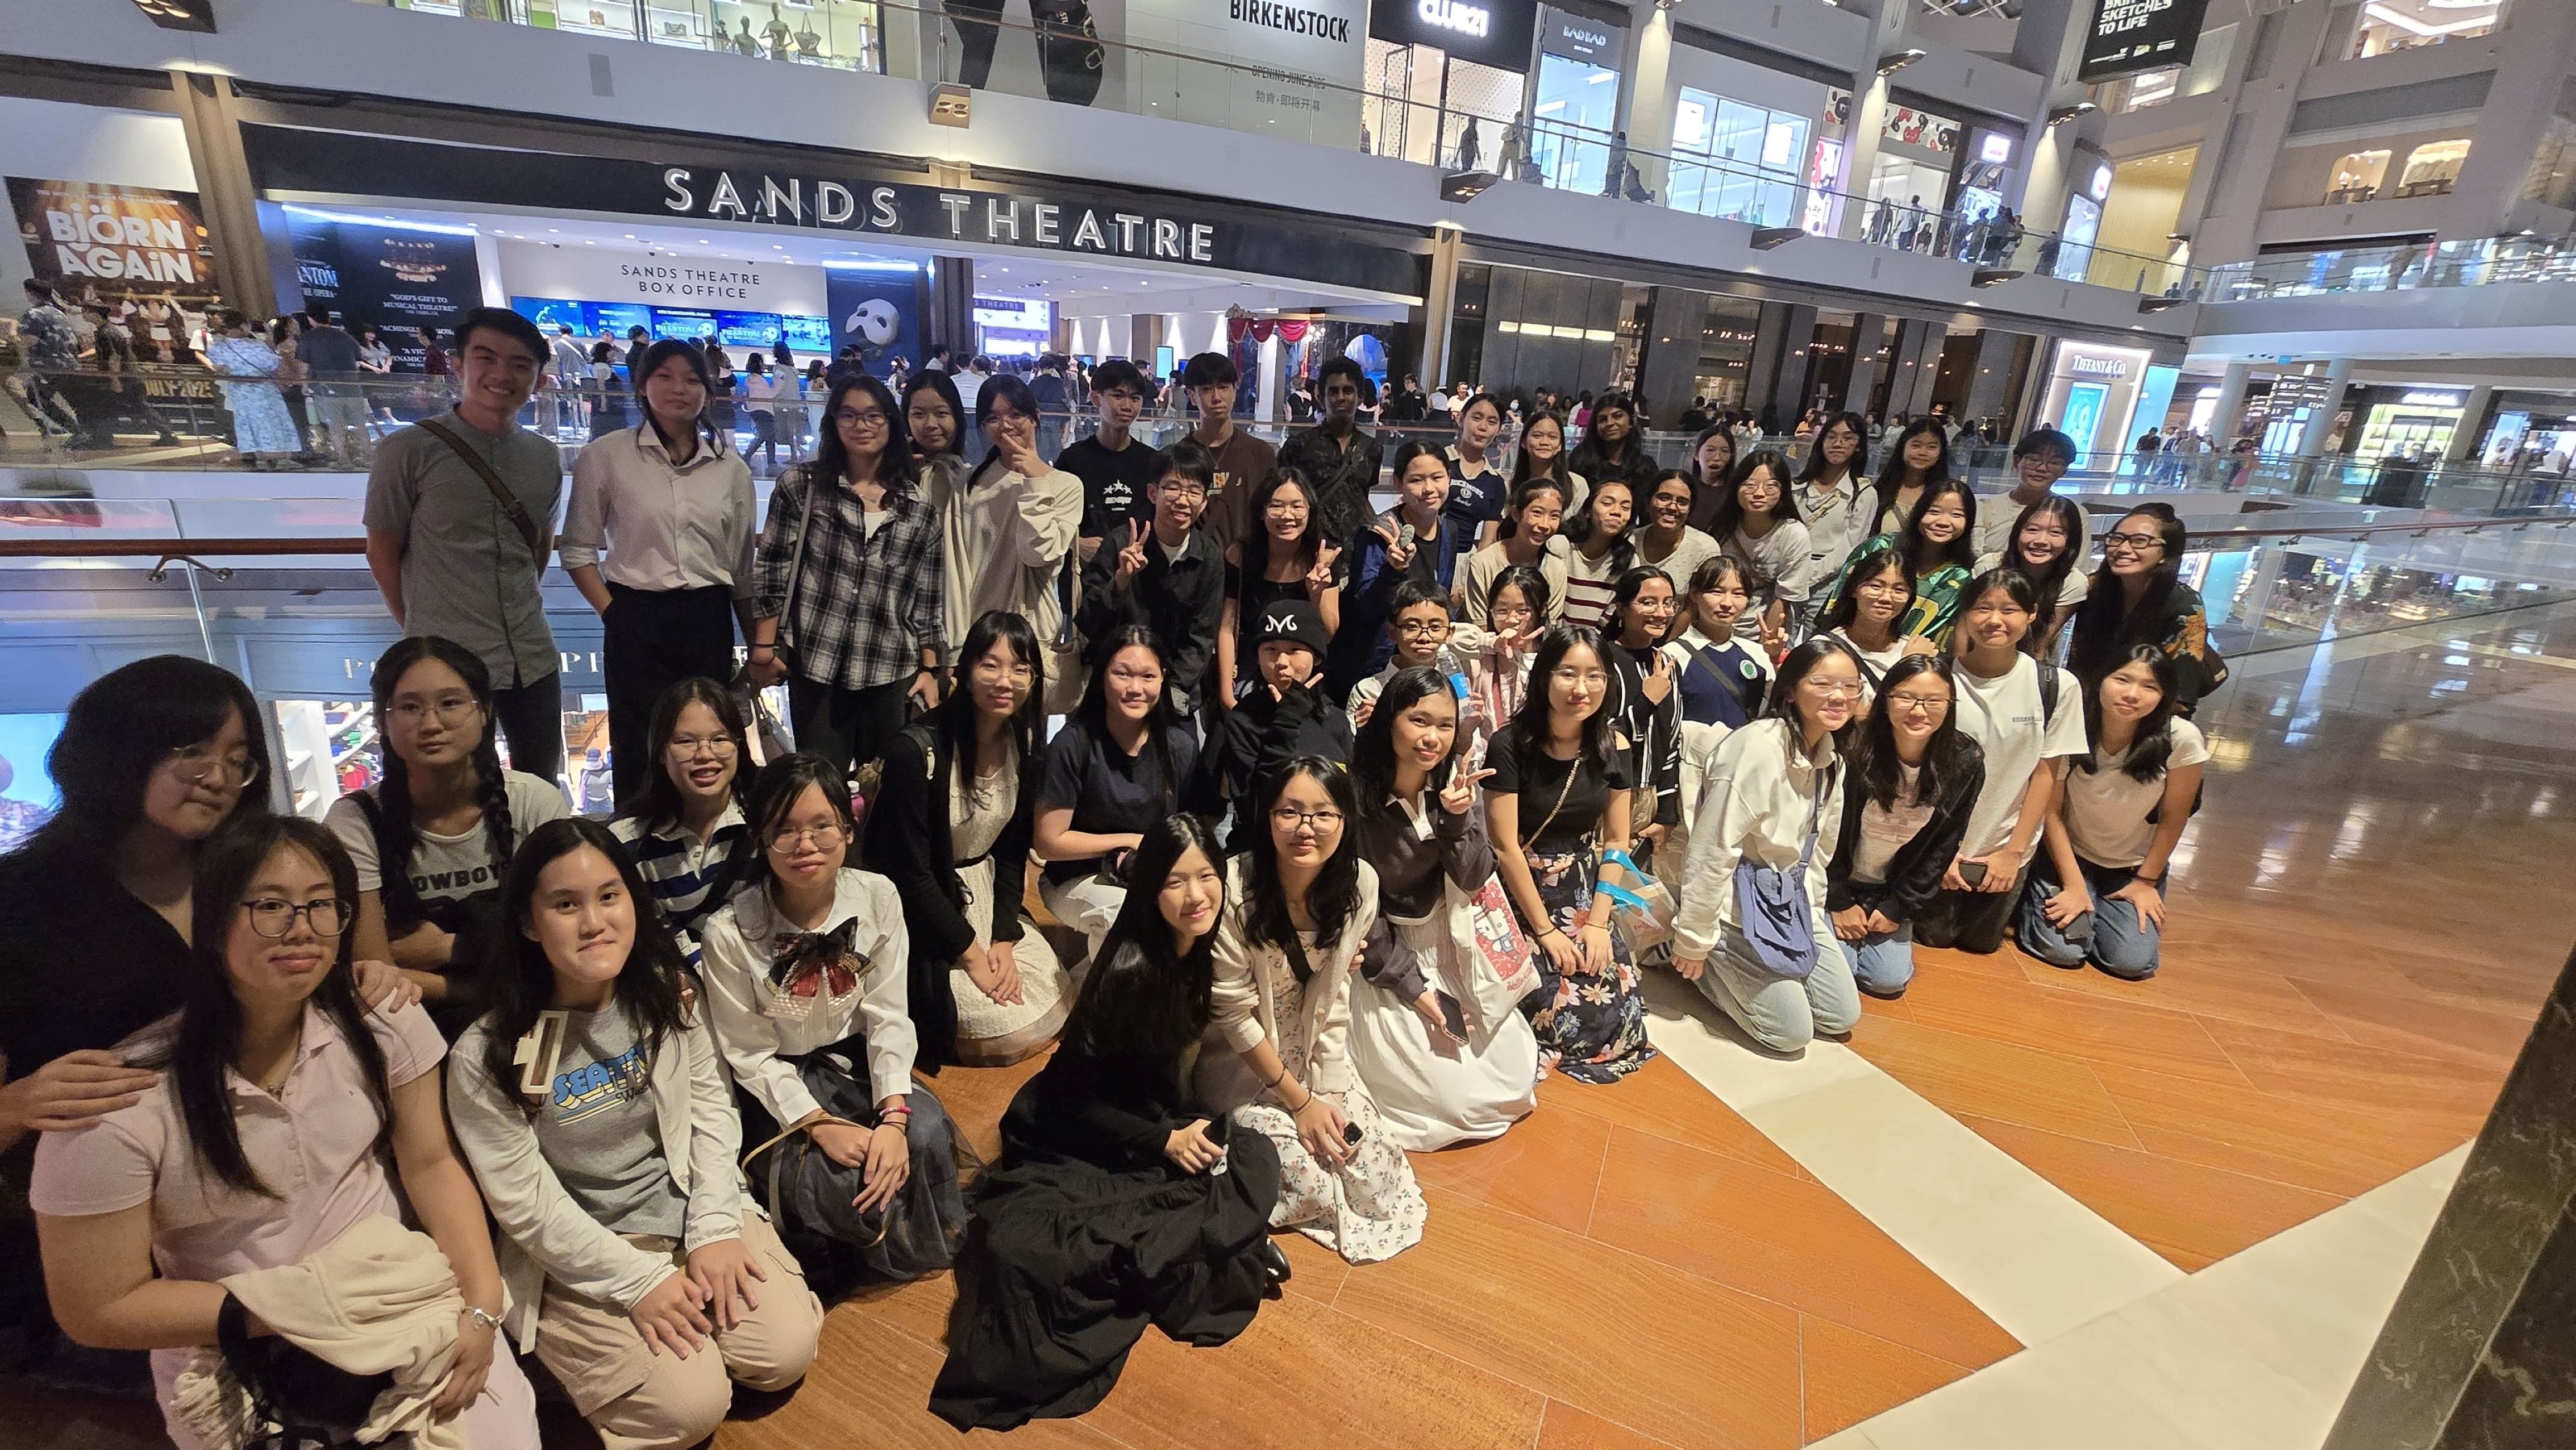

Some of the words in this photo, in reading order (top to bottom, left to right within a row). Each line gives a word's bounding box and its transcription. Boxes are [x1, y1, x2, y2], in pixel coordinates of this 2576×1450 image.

[1230, 0, 1349, 43] BIRKENSTOCK
[2100, 0, 2172, 23] SKETCHES
[2098, 22, 2116, 36] TO
[2117, 14, 2149, 31] LIFE
[1252, 65, 1285, 82] OPENING
[1287, 72, 1306, 86] JUNE
[664, 168, 897, 227] SANDS
[939, 193, 1213, 261] THEATRE
[55, 244, 195, 283] AGAiN
[621, 265, 677, 279] SANDS
[684, 269, 760, 285] THEATRE
[639, 281, 675, 294] BOX
[682, 285, 746, 298] OFFICE
[982, 301, 1019, 310] THEATRE
